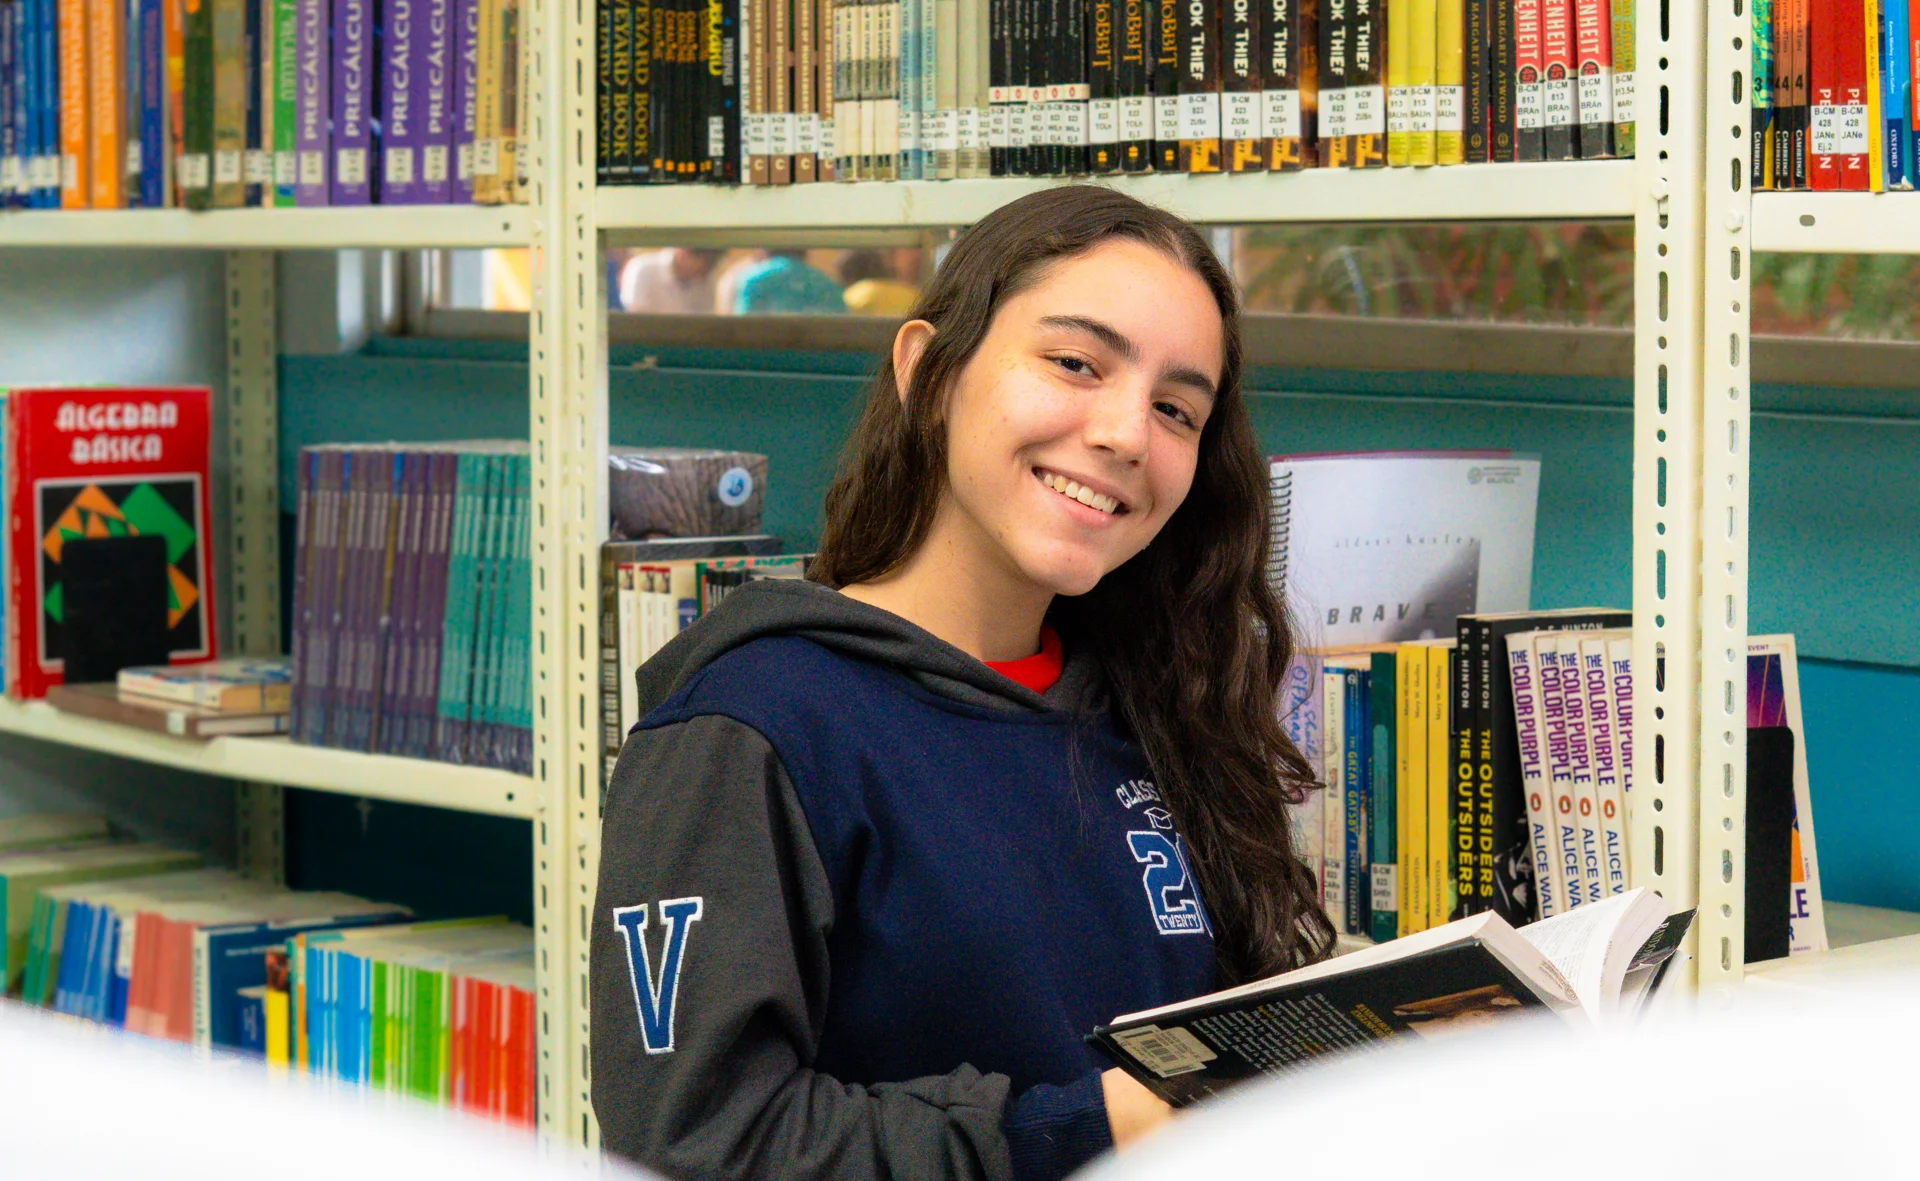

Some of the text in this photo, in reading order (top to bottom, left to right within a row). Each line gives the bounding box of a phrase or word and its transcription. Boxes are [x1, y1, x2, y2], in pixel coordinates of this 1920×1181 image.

[1123, 0, 1143, 66] OBBIT
[1355, 21, 1370, 72] THIEF
[1189, 32, 1206, 81] THIEF
[1233, 28, 1249, 78] THIEF
[1272, 27, 1288, 78] THIEF
[1329, 26, 1346, 76] THIEF
[1471, 2, 1480, 124] MARGARET ATWOOD
[1498, 0, 1508, 124] MARGARET ATWOOD
[613, 0, 630, 157] EYARD BOOK
[634, 0, 650, 157] EYARD BOOK
[1518, 84, 1539, 93] B-CM
[1547, 81, 1568, 90] B-CM
[1579, 78, 1601, 87] B-CM
[1615, 74, 1633, 83] B-CM
[1754, 77, 1763, 92] 3
[1781, 76, 1790, 91] 4
[1795, 74, 1803, 90] 4
[1269, 94, 1287, 102] B-CM
[1517, 107, 1540, 115] BRAn
[1547, 104, 1570, 112] BRAn
[1551, 93, 1565, 101] 813
[1580, 101, 1602, 109] BRAn
[1814, 107, 1835, 115] B-CM
[1841, 107, 1863, 115] B-CM
[1521, 118, 1536, 128] Ej.3
[1551, 115, 1566, 125] Ej.4
[1814, 131, 1835, 140] JANe
[1818, 119, 1832, 127] 428
[1841, 131, 1863, 140] JANe
[1845, 119, 1859, 127] 428
[1753, 131, 1762, 177] CAMBRIDGE
[1818, 142, 1833, 153] Ej.2
[1890, 128, 1898, 168] OXFORD
[55, 401, 178, 431] ÁLGEBRA
[70, 433, 163, 464] BÁSICA
[1327, 602, 1437, 626] BRAVE
[1747, 644, 1770, 652] EVENT
[1460, 627, 1470, 709] S. E. HINTON
[1481, 628, 1490, 710] S. E. HINTON
[1612, 659, 1632, 674] THE
[1510, 650, 1542, 781] THE COLOR PURPLE
[1539, 651, 1572, 783] THE COLOR PURPLE
[1560, 652, 1592, 785] THE COLOR PURPLE
[1585, 654, 1616, 786] THE COLOR PURPLE
[1347, 752, 1358, 786] GREAT
[1347, 790, 1358, 832] GATSBY
[1457, 728, 1474, 896] THE OUTSIDERS
[1479, 730, 1494, 897] THE OUTSIDERS
[1532, 822, 1550, 874] ALICE
[1560, 825, 1580, 877] ALICE
[1581, 827, 1600, 878] ALICE
[1605, 829, 1624, 881] ALICE
[1158, 912, 1201, 928] TWENTY
[612, 895, 703, 1055] V
